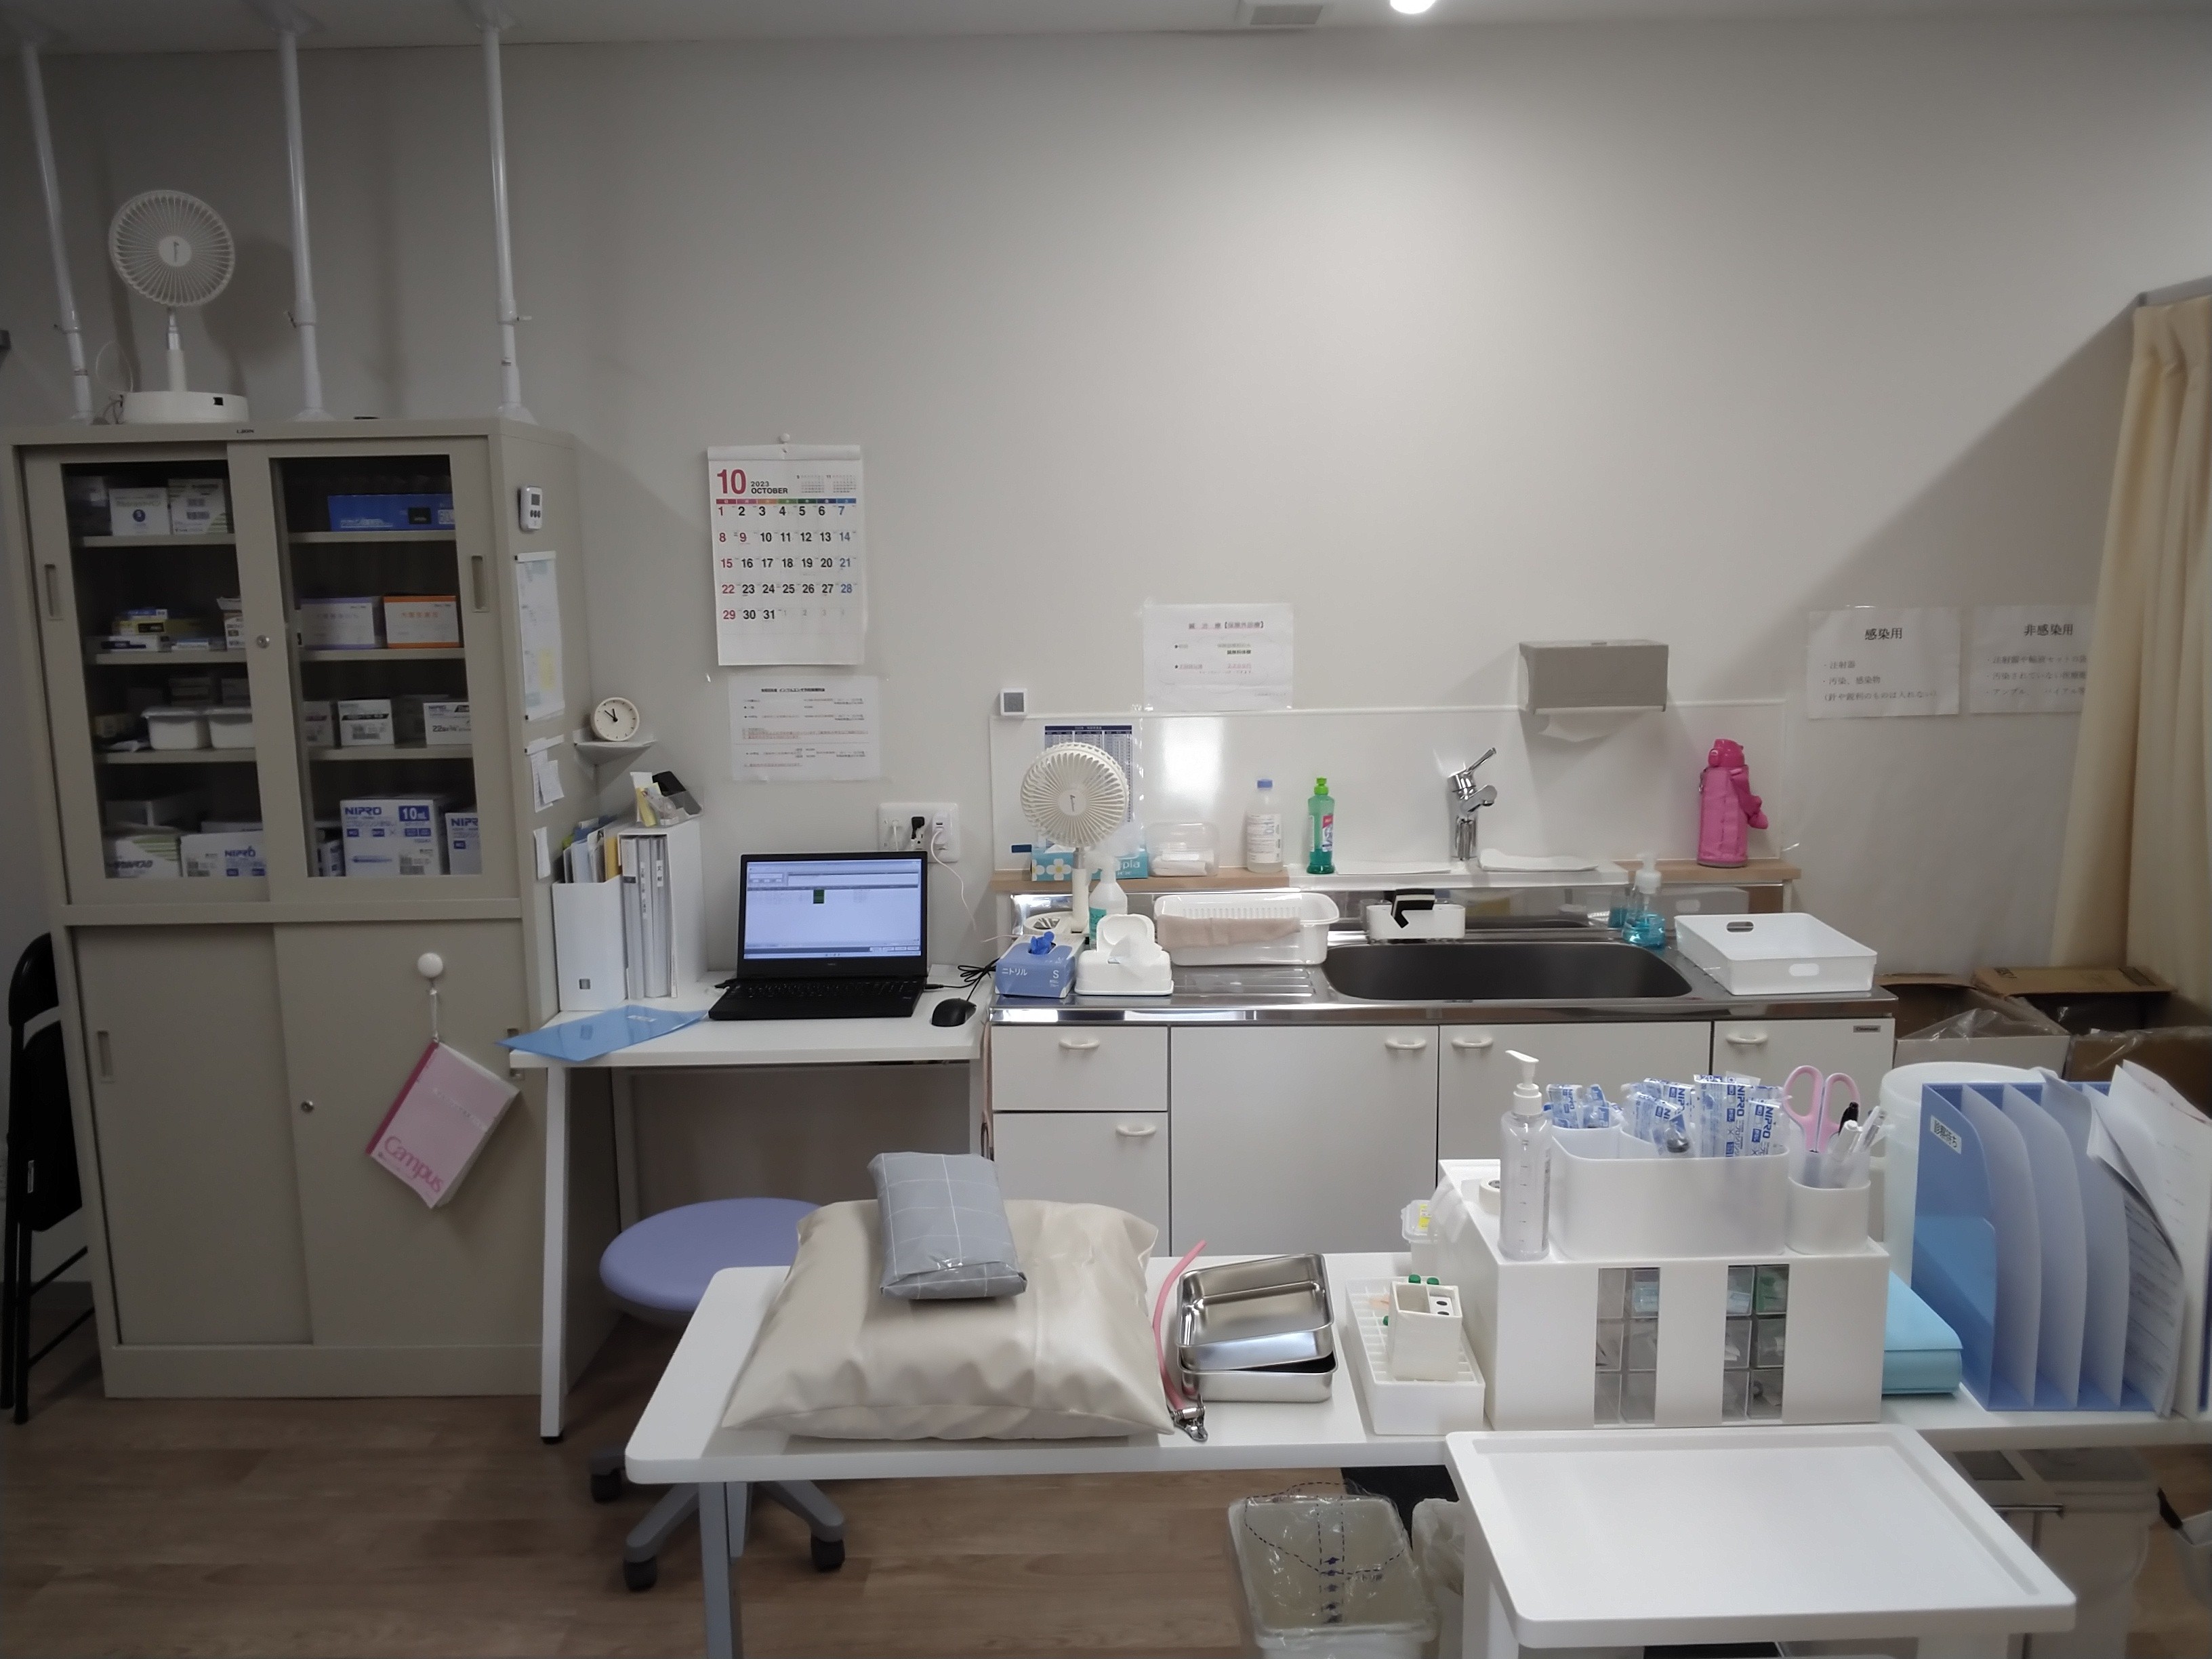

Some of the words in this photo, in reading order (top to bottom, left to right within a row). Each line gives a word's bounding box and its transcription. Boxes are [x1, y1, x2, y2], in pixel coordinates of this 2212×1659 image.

[717, 469, 746, 494] 10
[718, 506, 723, 516] 1
[738, 506, 745, 516] 2
[759, 506, 766, 516] 3
[779, 506, 786, 516] 4
[799, 506, 806, 516] 5
[818, 506, 825, 516] 6
[838, 506, 844, 515] 7
[719, 533, 726, 542] 8
[739, 533, 747, 542] 9
[760, 532, 772, 541] 10
[780, 532, 791, 541] 11
[800, 532, 812, 541] 12
[820, 532, 831, 541] 13
[840, 532, 851, 541] 14
[720, 558, 733, 568] 15
[741, 558, 753, 568] 16
[762, 558, 773, 568] 17
[782, 558, 793, 568] 18
[802, 558, 813, 568] 19
[820, 558, 832, 567] 20
[840, 558, 851, 567] 21
[722, 584, 735, 594] 22
[742, 584, 755, 594] 23
[762, 584, 775, 594] 24
[782, 584, 795, 594] 25
[802, 584, 815, 594] 26
[821, 584, 834, 593] 27
[840, 583, 853, 593] 28
[723, 610, 735, 619] 29
[743, 610, 756, 619] 30
[763, 610, 775, 619] 31
[1864, 628, 1903, 640] 感染用
[2024, 623, 2074, 636] 非感染用
[345, 806, 382, 815] NIPRO
[451, 817, 478, 827] NIPR
[225, 849, 256, 857] NIPRO
[1002, 968, 1028, 976] ニトリル
[1052, 970, 1059, 979] S
[1737, 1086, 1745, 1117] NIPRO
[1762, 1106, 1774, 1139] NIPRO
[384, 1135, 445, 1193] Campus
